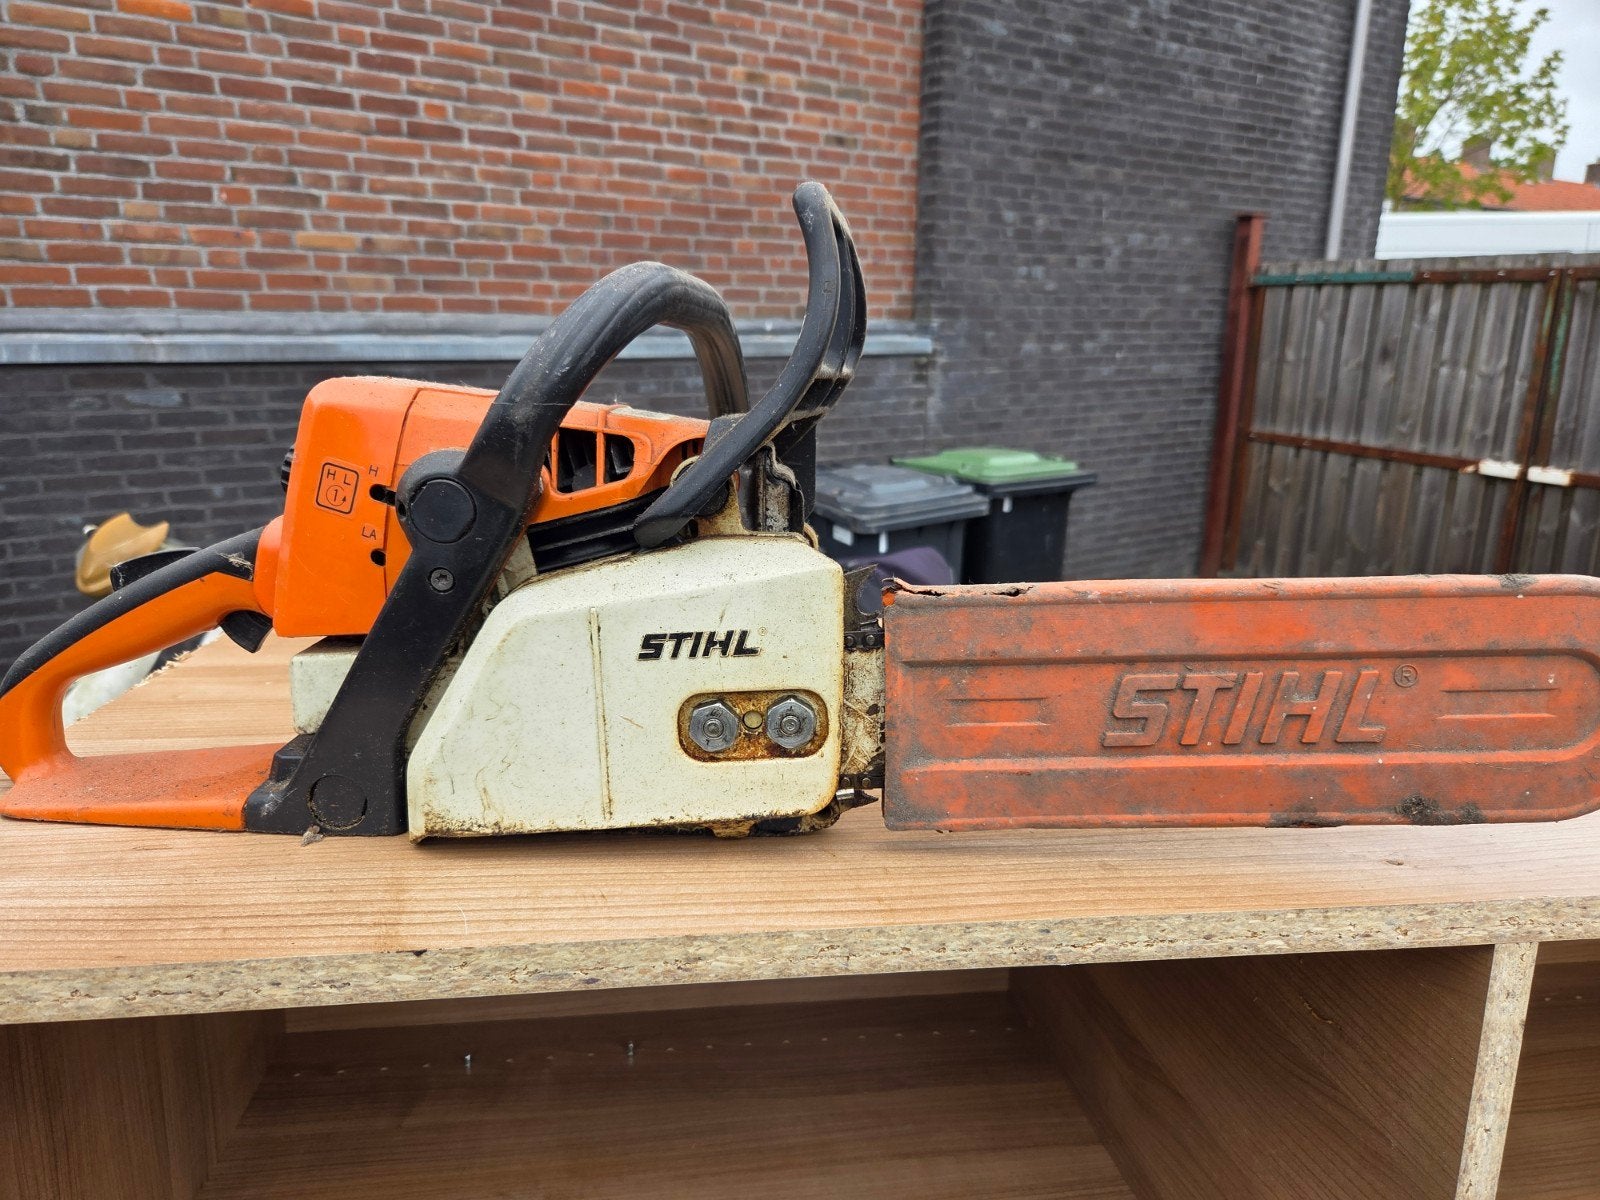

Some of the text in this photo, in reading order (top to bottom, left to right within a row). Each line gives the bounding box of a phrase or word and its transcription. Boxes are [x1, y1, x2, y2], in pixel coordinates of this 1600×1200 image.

[326, 468, 352, 486] H L
[368, 464, 379, 477] H
[361, 526, 377, 541] LA
[638, 629, 762, 661] STIHL
[1102, 670, 1387, 747] STIHL
